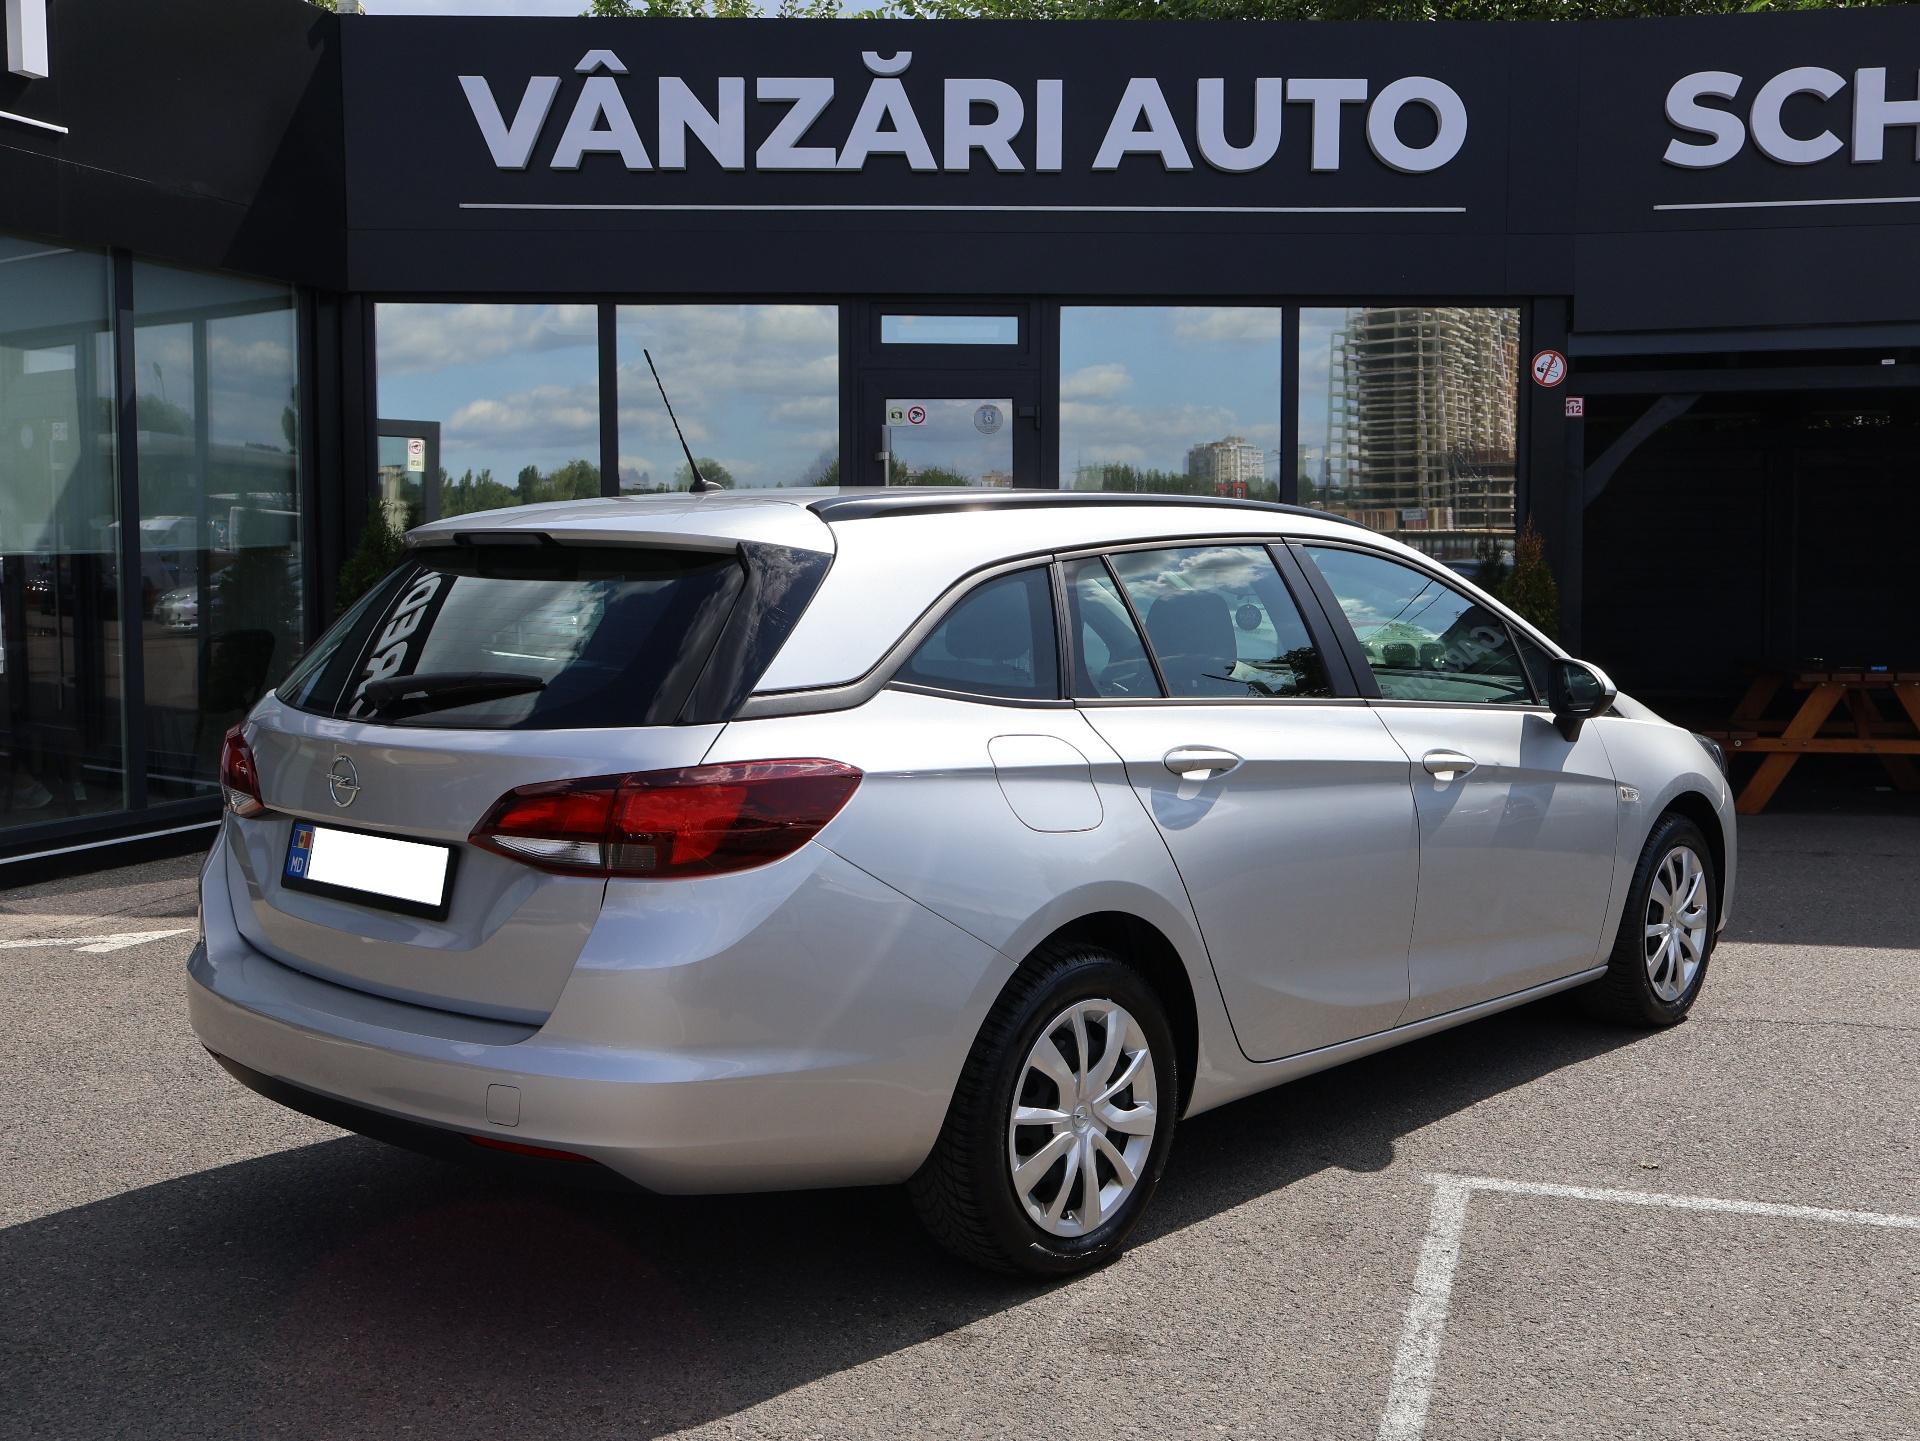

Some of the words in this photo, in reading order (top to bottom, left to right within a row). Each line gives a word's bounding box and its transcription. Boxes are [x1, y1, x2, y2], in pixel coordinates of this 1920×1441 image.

[458, 49, 1063, 173] VÂNZĂRI
[1091, 76, 1468, 174] AUTO
[1566, 405, 1582, 414] 112
[290, 855, 304, 873] MD
